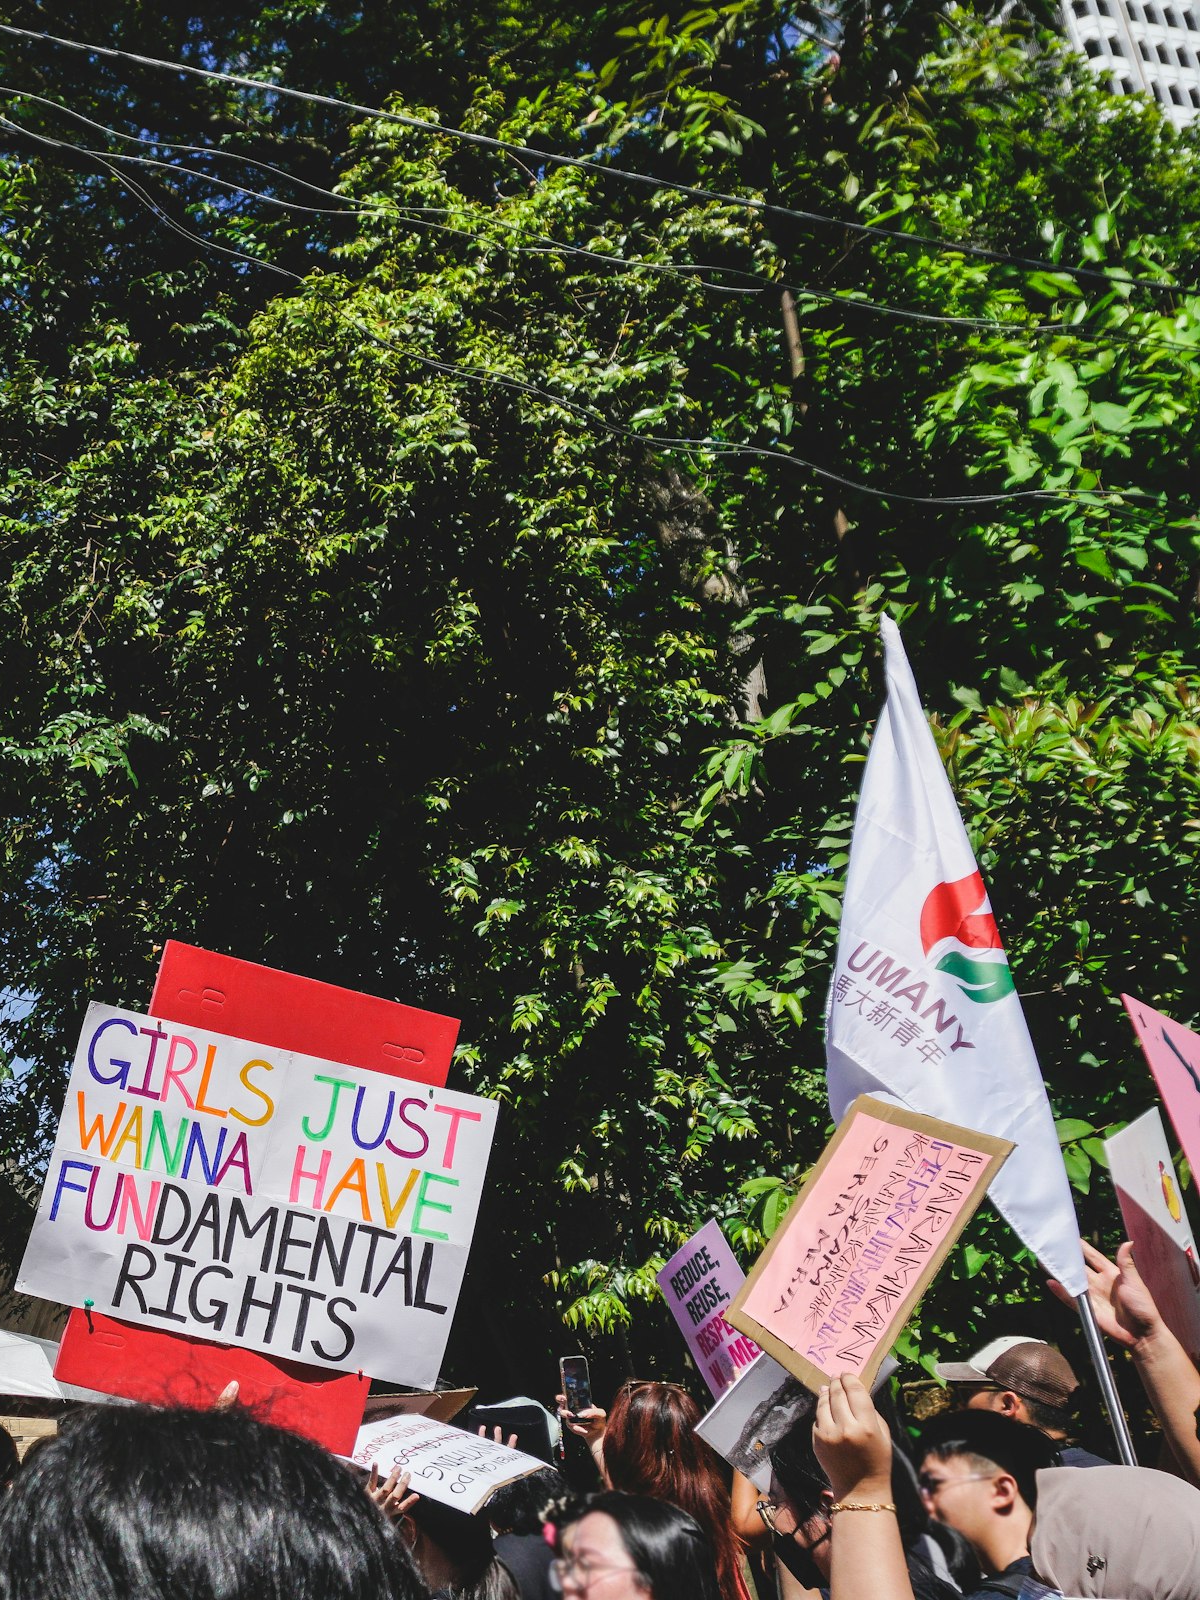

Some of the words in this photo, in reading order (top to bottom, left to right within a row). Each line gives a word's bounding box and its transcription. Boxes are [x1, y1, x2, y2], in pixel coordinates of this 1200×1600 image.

[847, 941, 976, 1053] UMANY
[87, 1017, 274, 1126] GIRLS
[301, 1074, 481, 1169] JUST
[76, 1090, 254, 1196] WANNA
[288, 1144, 460, 1240] HAVE
[828, 1135, 889, 1217] SERTA
[48, 1160, 448, 1315] FUNDAMENTAL
[669, 1245, 721, 1301] REDUCE,
[774, 1228, 830, 1313] MERTA
[806, 1140, 953, 1364] PERKAHWINAN
[809, 1194, 870, 1286] SECARA
[835, 1152, 983, 1366] HARAMKAN
[111, 1243, 358, 1362] RIGHTS
[685, 1277, 731, 1327] REUSE,
[695, 1308, 736, 1360] RESPE
[414, 1441, 501, 1481] ANYTHING
[450, 1473, 475, 1494] DO
